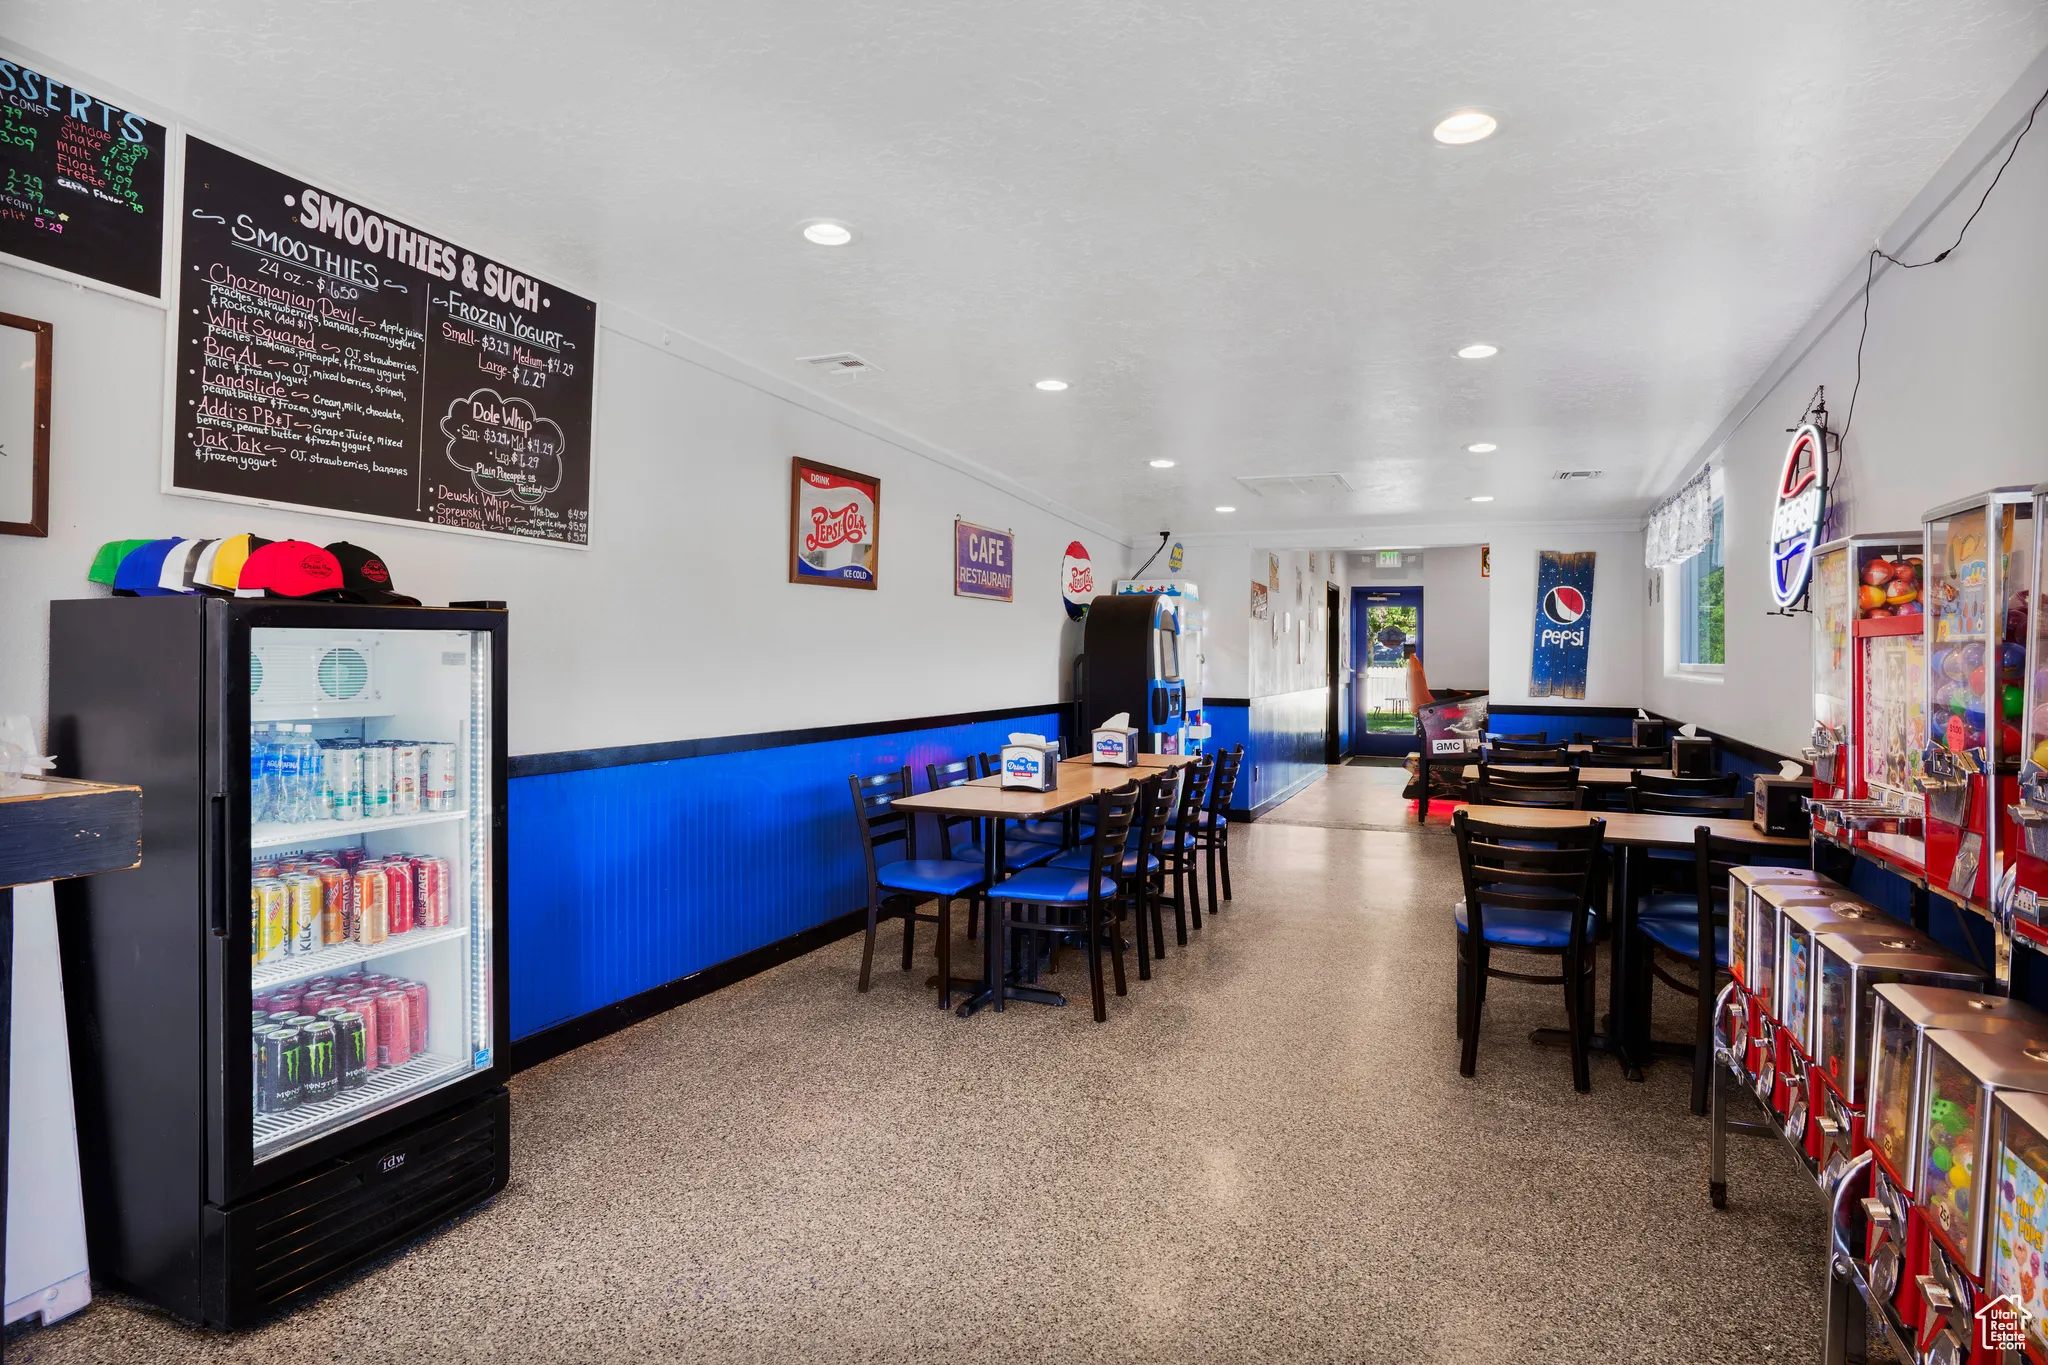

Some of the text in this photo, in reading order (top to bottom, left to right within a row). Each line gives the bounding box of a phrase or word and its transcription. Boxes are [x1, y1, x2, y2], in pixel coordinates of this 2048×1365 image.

[9, 95, 49, 117] CONES
[63, 115, 111, 142] Sundae
[61, 126, 138, 166] Shake 4.39
[56, 163, 105, 188] Freeze
[57, 153, 132, 188] Float 4.09
[0, 208, 63, 234] plit 5.29
[232, 214, 379, 288] SMOOTHIES
[300, 189, 539, 313] SMOOTHIES & SUCH
[258, 258, 279, 278] 24
[209, 263, 314, 317] Chazmanian
[316, 298, 356, 325] Devil
[380, 319, 404, 335] Apple
[220, 297, 272, 320] ROCKSTAR
[207, 305, 249, 333] Whit
[252, 319, 317, 351] Squared
[449, 290, 563, 349] FROZEN YOGURT
[361, 327, 388, 343] frozen
[387, 338, 416, 350] yogurt
[442, 322, 475, 345] Small
[512, 345, 543, 370] Medium
[241, 364, 273, 379] frozen
[313, 370, 339, 382] mixed
[347, 359, 376, 374] frozen
[376, 368, 406, 383] yogurt
[478, 352, 508, 380] Large
[202, 366, 287, 398] Landslide
[202, 384, 237, 398] peanut
[237, 389, 267, 404] butter
[277, 398, 310, 414] frozen
[310, 408, 341, 420] yogurt
[197, 395, 247, 420] Addi's
[253, 406, 293, 429] PB&J
[313, 424, 344, 439] Grape
[377, 437, 403, 448] mixed
[473, 401, 533, 439] Dole Whip
[193, 427, 228, 450] Jak
[230, 434, 263, 453] Jak
[373, 461, 408, 476] bananas
[237, 423, 269, 435] peanut
[271, 427, 302, 441] butter
[310, 435, 340, 448] frozen
[341, 442, 371, 454] yogurt
[201, 446, 238, 463] frozen
[238, 457, 277, 470] yogurt
[475, 462, 526, 483] Plain Pineapple
[810, 473, 830, 486] DRINK
[438, 485, 479, 505] Dewski
[481, 492, 510, 514] Whip
[516, 482, 542, 494] Twisted
[436, 503, 482, 521] Sprewski
[484, 508, 512, 527] Whip
[437, 516, 460, 528] Dole
[460, 518, 487, 531] Float
[969, 533, 1004, 567] CAFE
[1379, 551, 1399, 566] EXIT
[843, 569, 867, 580] ICE COLD
[959, 566, 1012, 589] RESTAURANT
[1541, 627, 1584, 649] pepsi
[383, 1153, 406, 1170] idw
[2016, 1195, 2035, 1221] TINY
